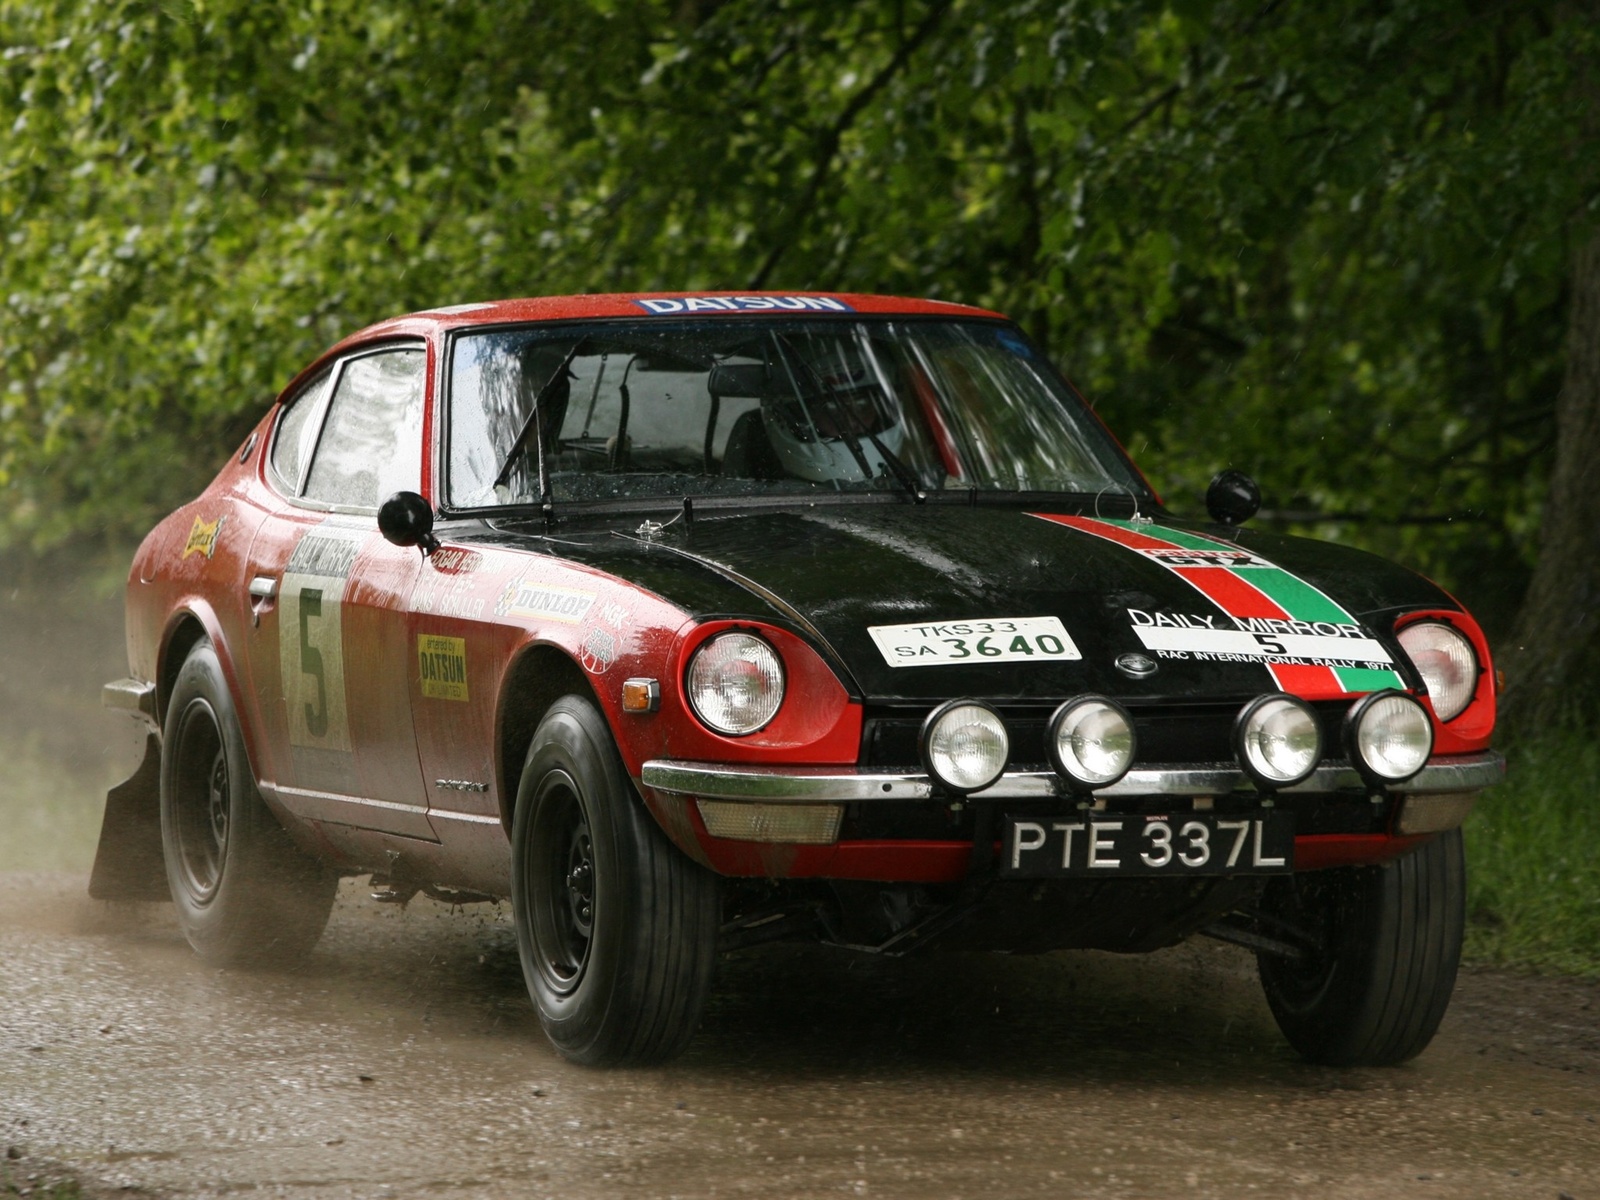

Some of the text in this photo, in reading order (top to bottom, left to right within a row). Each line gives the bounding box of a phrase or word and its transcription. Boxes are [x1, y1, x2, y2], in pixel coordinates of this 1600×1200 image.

[639, 297, 846, 313] DATSUN
[431, 549, 463, 569] EDGAR
[1154, 556, 1270, 565] GTX
[515, 589, 590, 615] DUNLOP
[602, 599, 630, 630] NGK
[1127, 608, 1367, 639] DAILY MIRROR
[591, 627, 615, 648] SPARK
[911, 622, 1017, 637] TKS33
[426, 639, 456, 654] entered by
[587, 641, 611, 662] PLUGS
[894, 635, 1065, 658] SA 3640
[1250, 634, 1288, 654] 5
[300, 588, 328, 738] 5
[421, 652, 464, 684] DATSUN
[1157, 650, 1393, 671] RAC INTERNATIONAL RALLY 1971
[1012, 820, 1285, 868] PTE 337L
